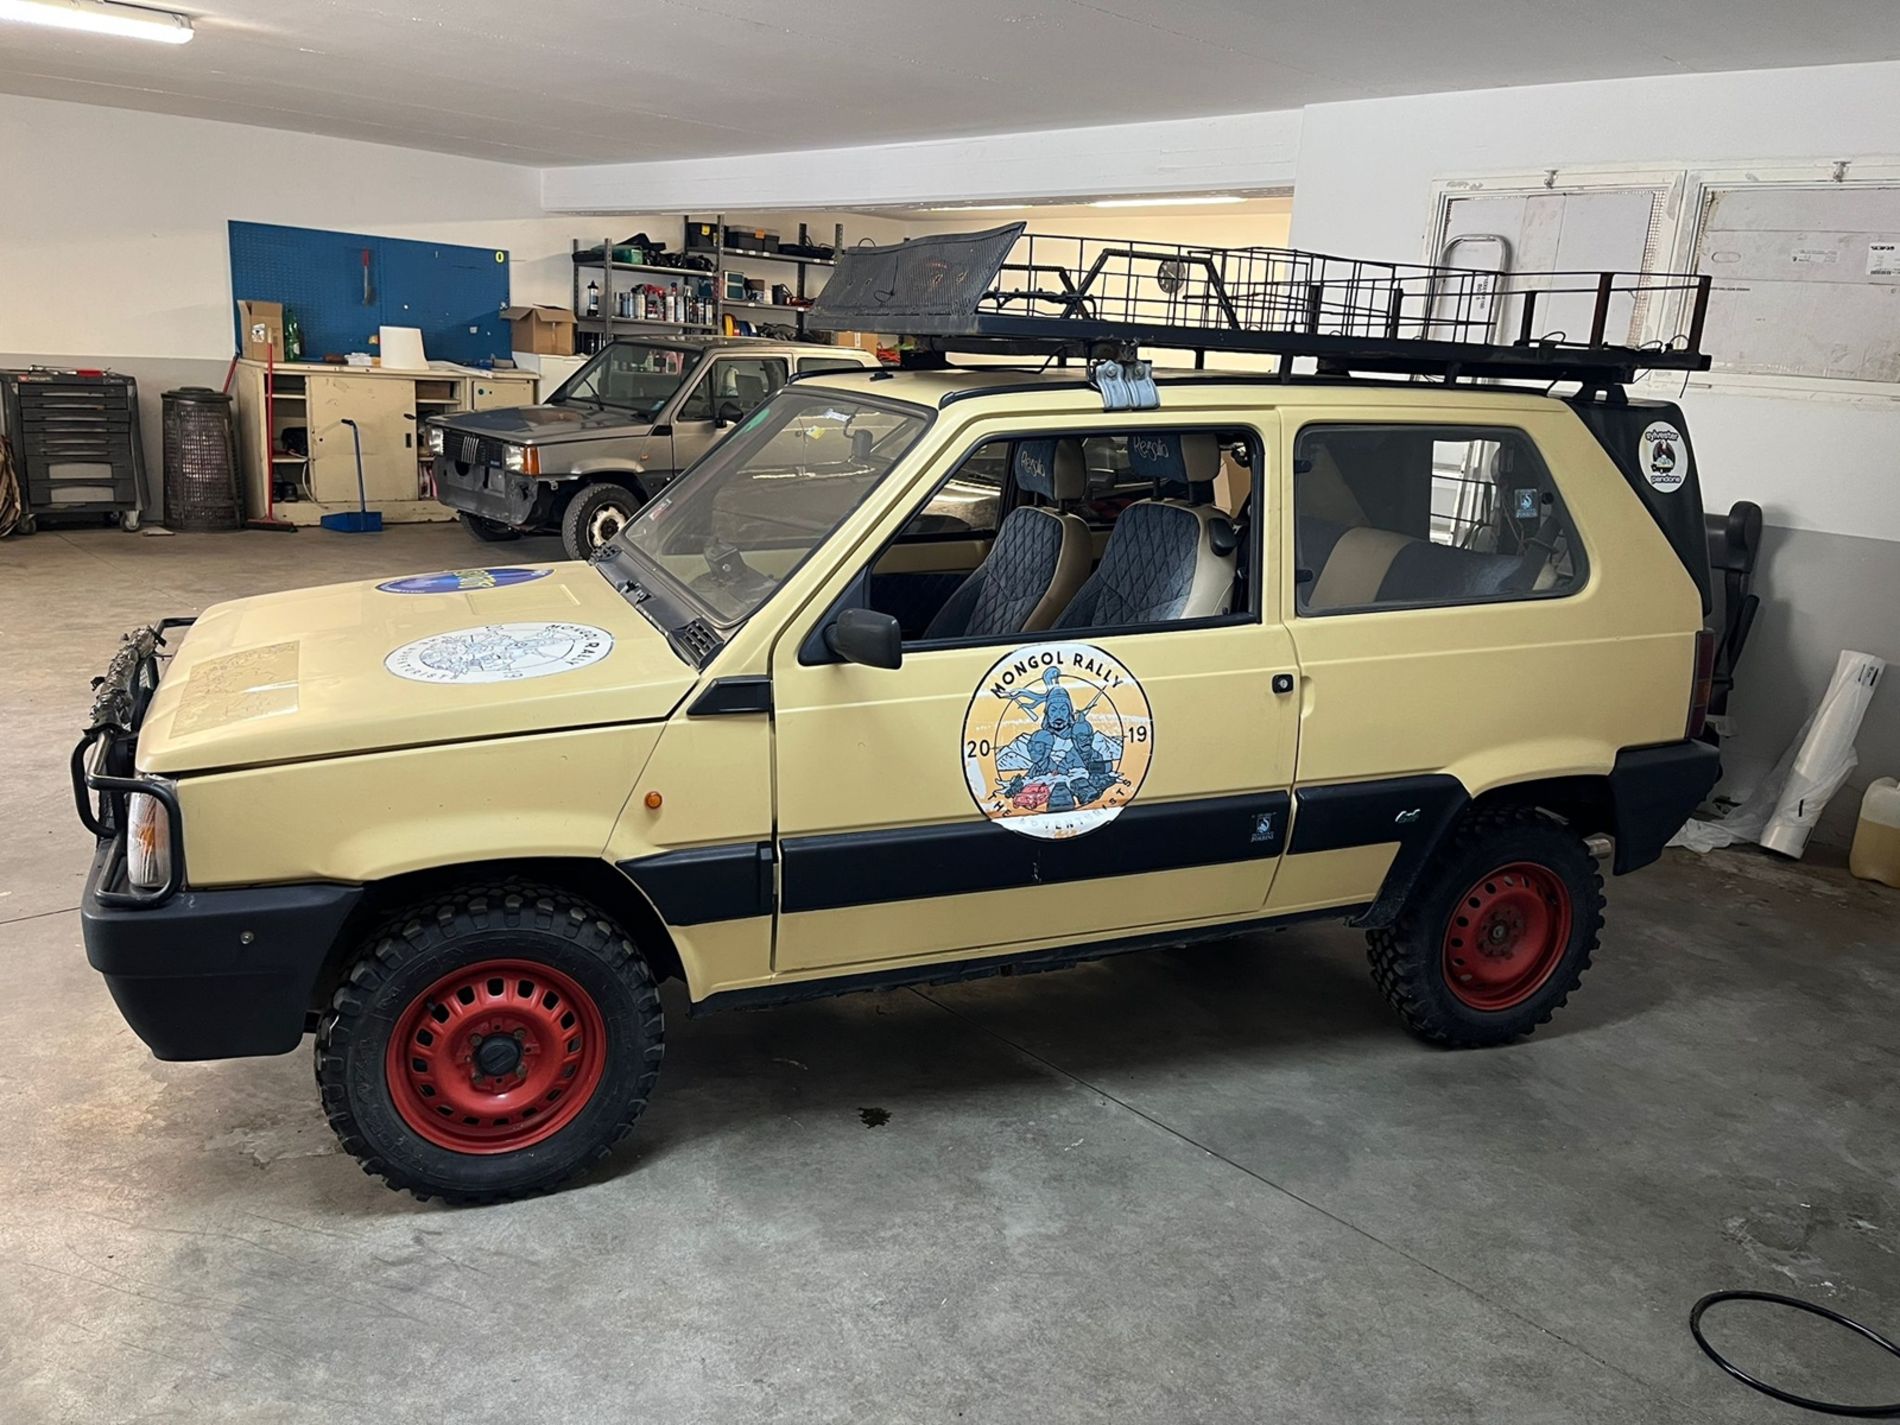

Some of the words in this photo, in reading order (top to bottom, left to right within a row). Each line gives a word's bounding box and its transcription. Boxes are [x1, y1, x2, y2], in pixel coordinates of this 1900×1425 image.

[990, 651, 1064, 699] MONGOL
[1073, 652, 1123, 689] RALLY
[967, 739, 990, 758] 20
[1128, 726, 1147, 743] 19
[987, 792, 1012, 818] THE
